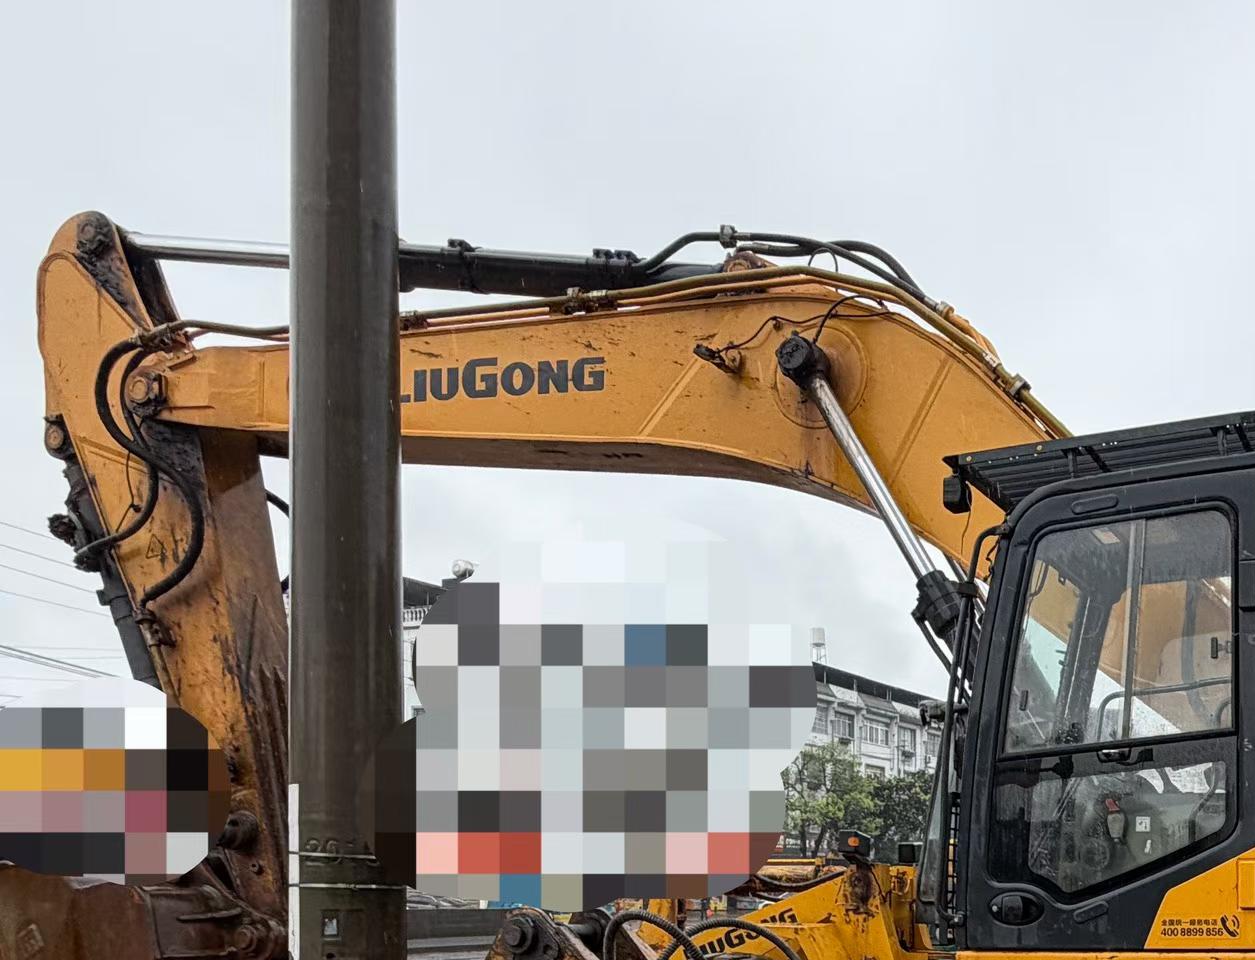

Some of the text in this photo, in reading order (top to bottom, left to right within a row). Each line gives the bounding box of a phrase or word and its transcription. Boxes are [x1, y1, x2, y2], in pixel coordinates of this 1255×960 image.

[400, 356, 605, 403] IUGONG
[1160, 927, 1224, 937] 400 8899 856
